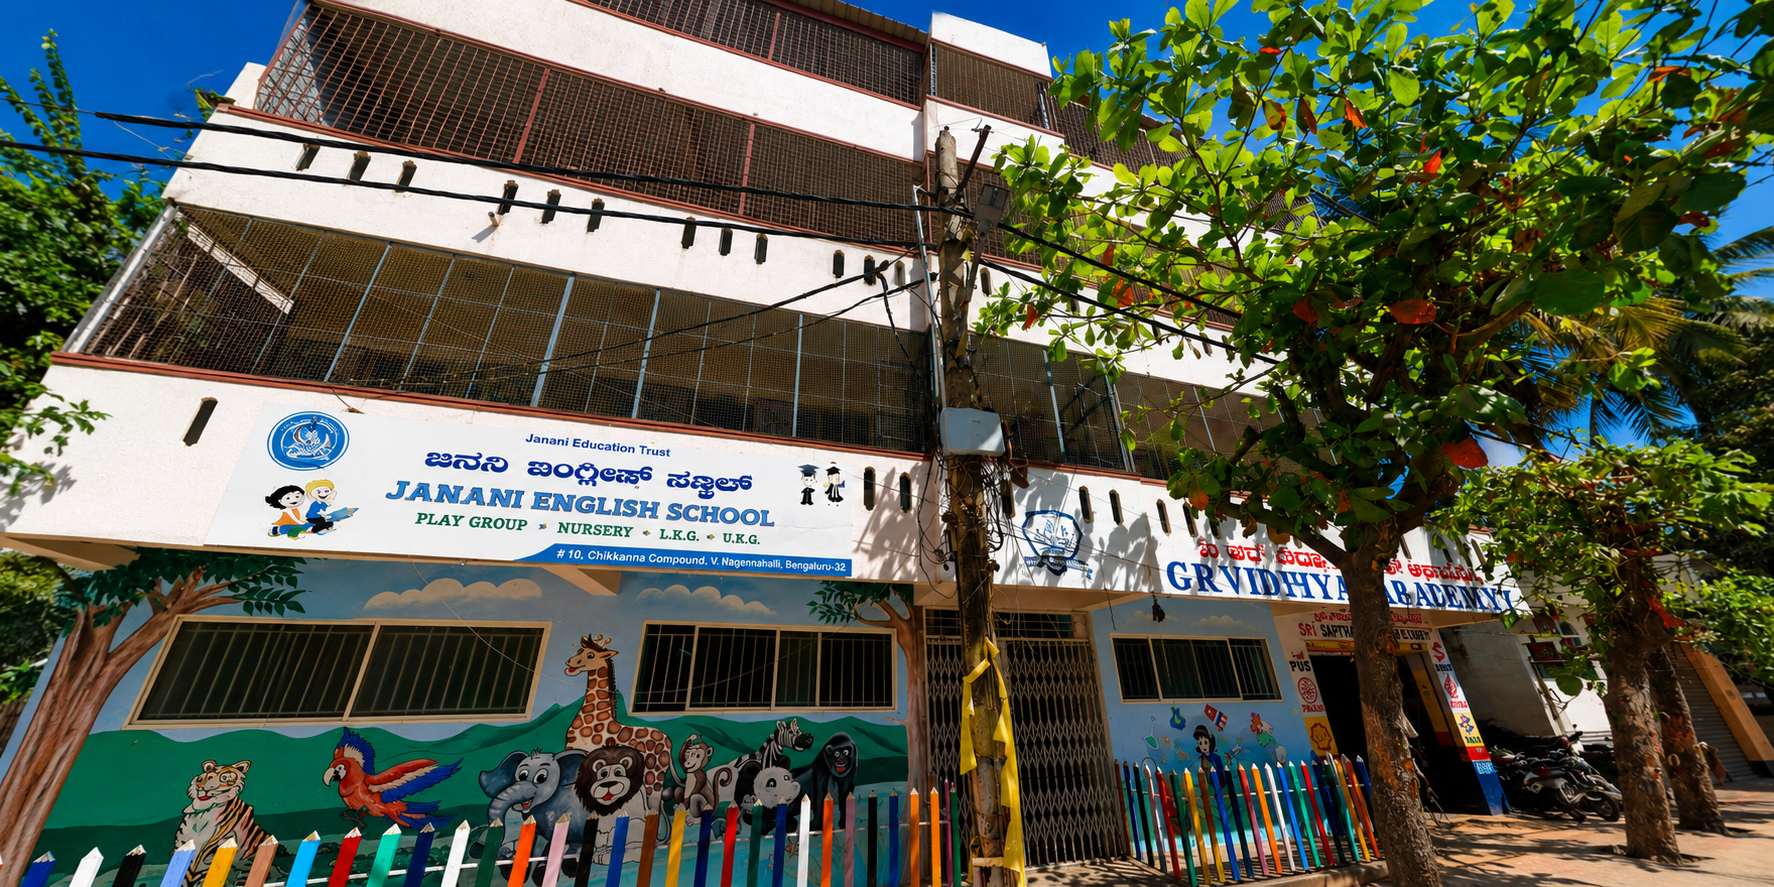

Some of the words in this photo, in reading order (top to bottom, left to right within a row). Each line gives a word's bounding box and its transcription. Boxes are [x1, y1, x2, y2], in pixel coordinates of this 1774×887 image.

[525, 433, 569, 447] Janani
[572, 438, 636, 454] Education
[639, 445, 671, 458] Trust
[385, 480, 525, 509] JANANI
[531, 491, 660, 519] ENGLISH
[666, 502, 775, 527] SCHOOL
[415, 512, 465, 527] PLAY
[468, 516, 528, 531] GROUP
[557, 522, 634, 538] NURSERY
[659, 528, 700, 542] L.K.G.
[722, 532, 761, 545] U.K.G.
[587, 550, 646, 562] Chikkanna
[1320, 624, 1353, 638] SAPTH
